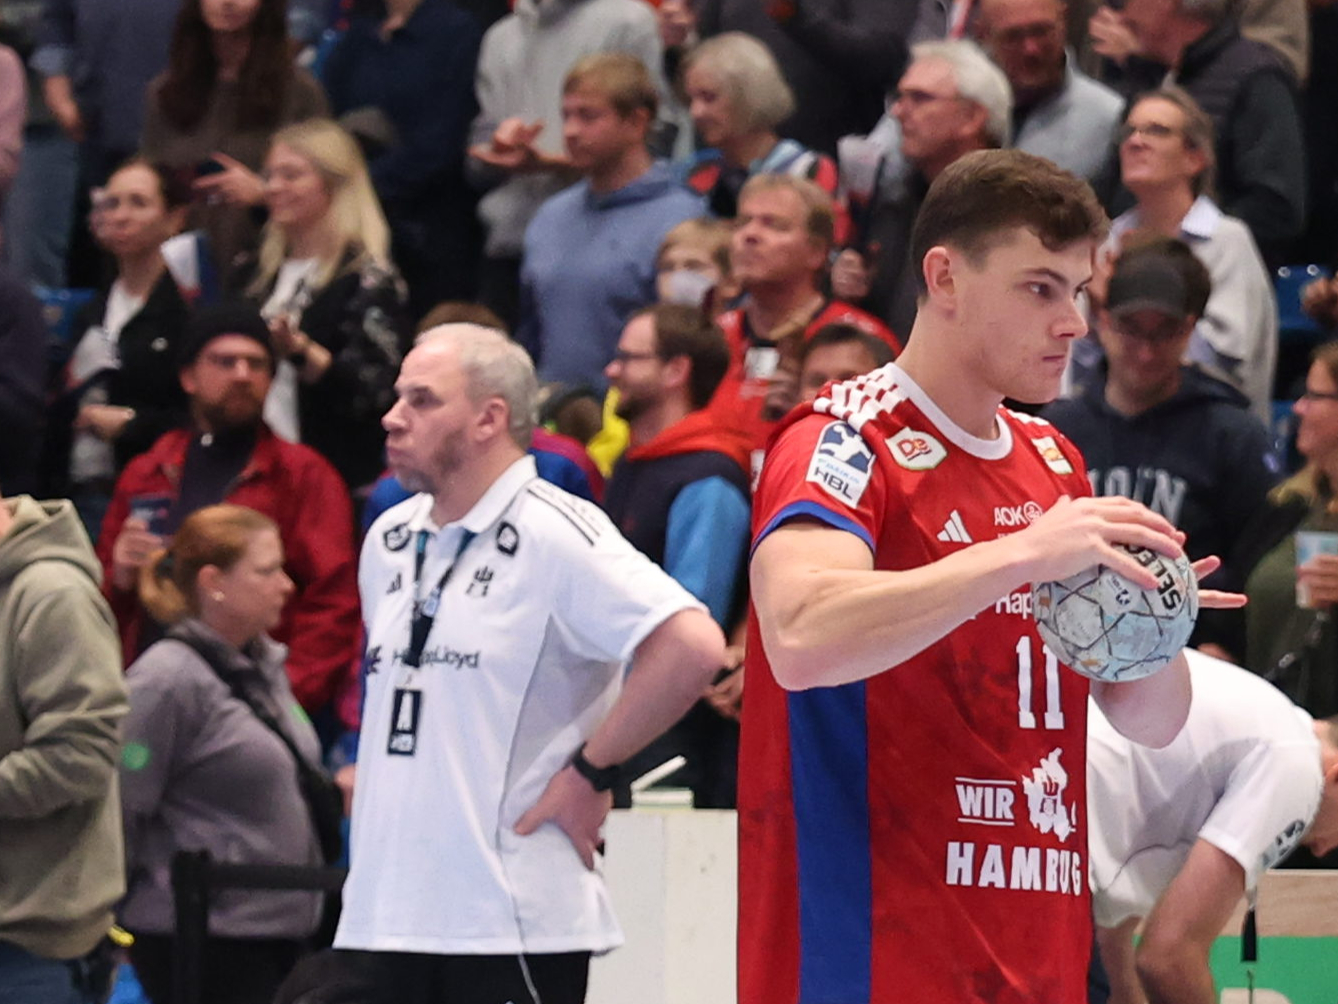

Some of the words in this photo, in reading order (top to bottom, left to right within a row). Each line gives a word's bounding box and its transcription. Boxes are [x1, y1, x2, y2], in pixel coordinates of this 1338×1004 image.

[814, 467, 853, 500] HBL
[994, 506, 1027, 526] AOK
[1016, 636, 1064, 729] 11
[956, 785, 1015, 819] WIR
